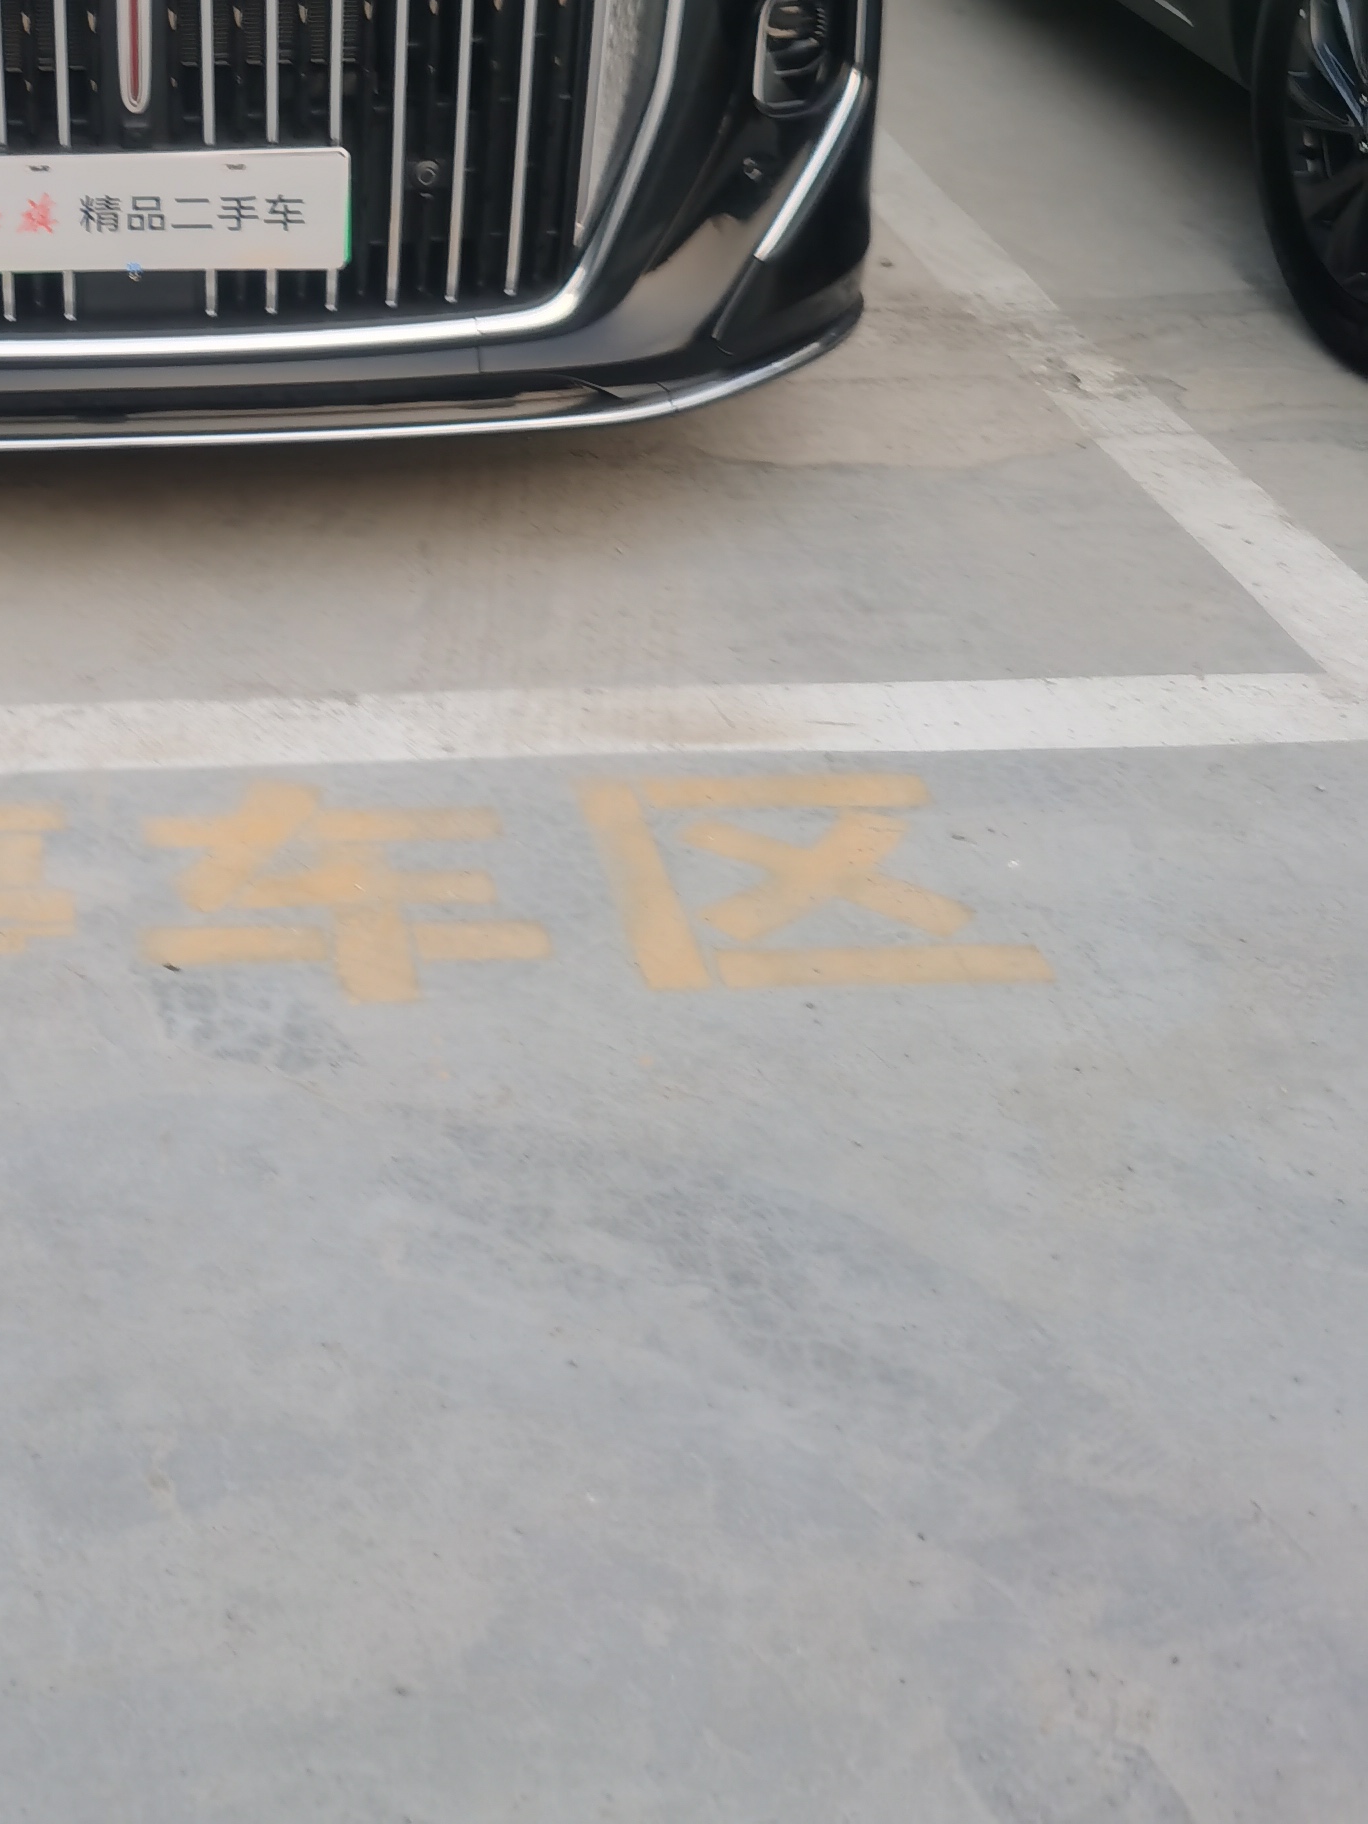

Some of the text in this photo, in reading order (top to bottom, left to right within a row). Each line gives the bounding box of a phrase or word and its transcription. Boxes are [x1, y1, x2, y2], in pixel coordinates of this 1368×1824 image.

[78, 193, 307, 234] 精品二手车
